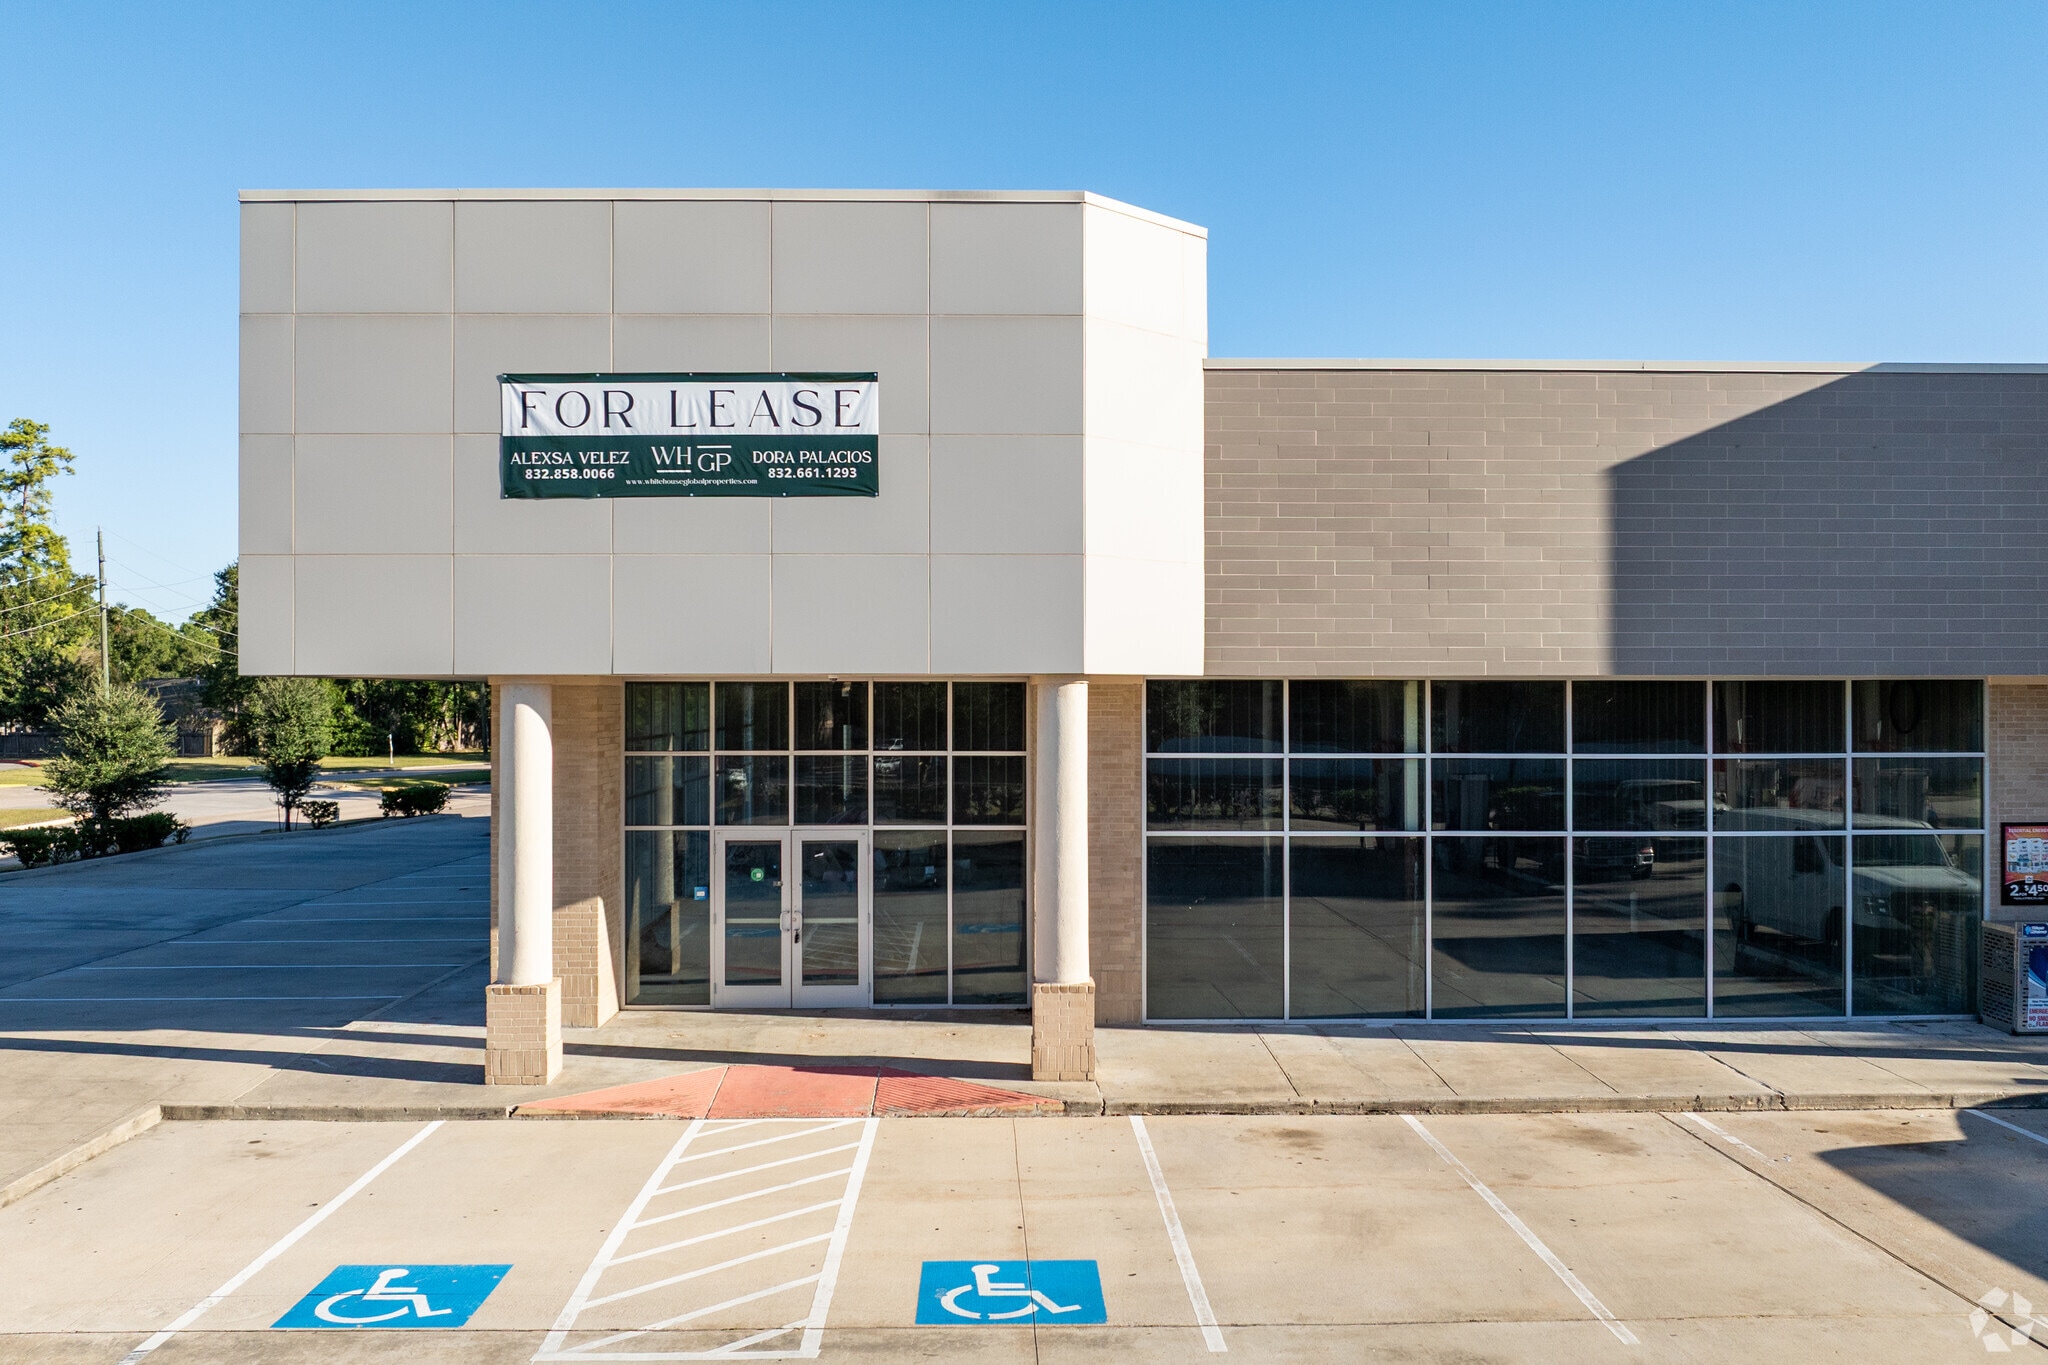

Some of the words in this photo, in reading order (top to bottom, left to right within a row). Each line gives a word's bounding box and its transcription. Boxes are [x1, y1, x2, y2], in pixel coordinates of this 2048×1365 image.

[520, 390, 635, 429] FOR
[670, 389, 861, 429] LEASE
[510, 451, 574, 465] ALEXSA
[578, 451, 630, 465] VELEZ
[650, 446, 692, 465] WH
[752, 450, 795, 464] DORA
[799, 450, 872, 464] PALACIOS
[697, 453, 732, 473] GP
[525, 468, 615, 480] 832.858.0066
[768, 467, 857, 479] 832.661.1293
[625, 478, 758, 487] www.whitehouseglobalproperties.com
[2010, 884, 2019, 896] 2
